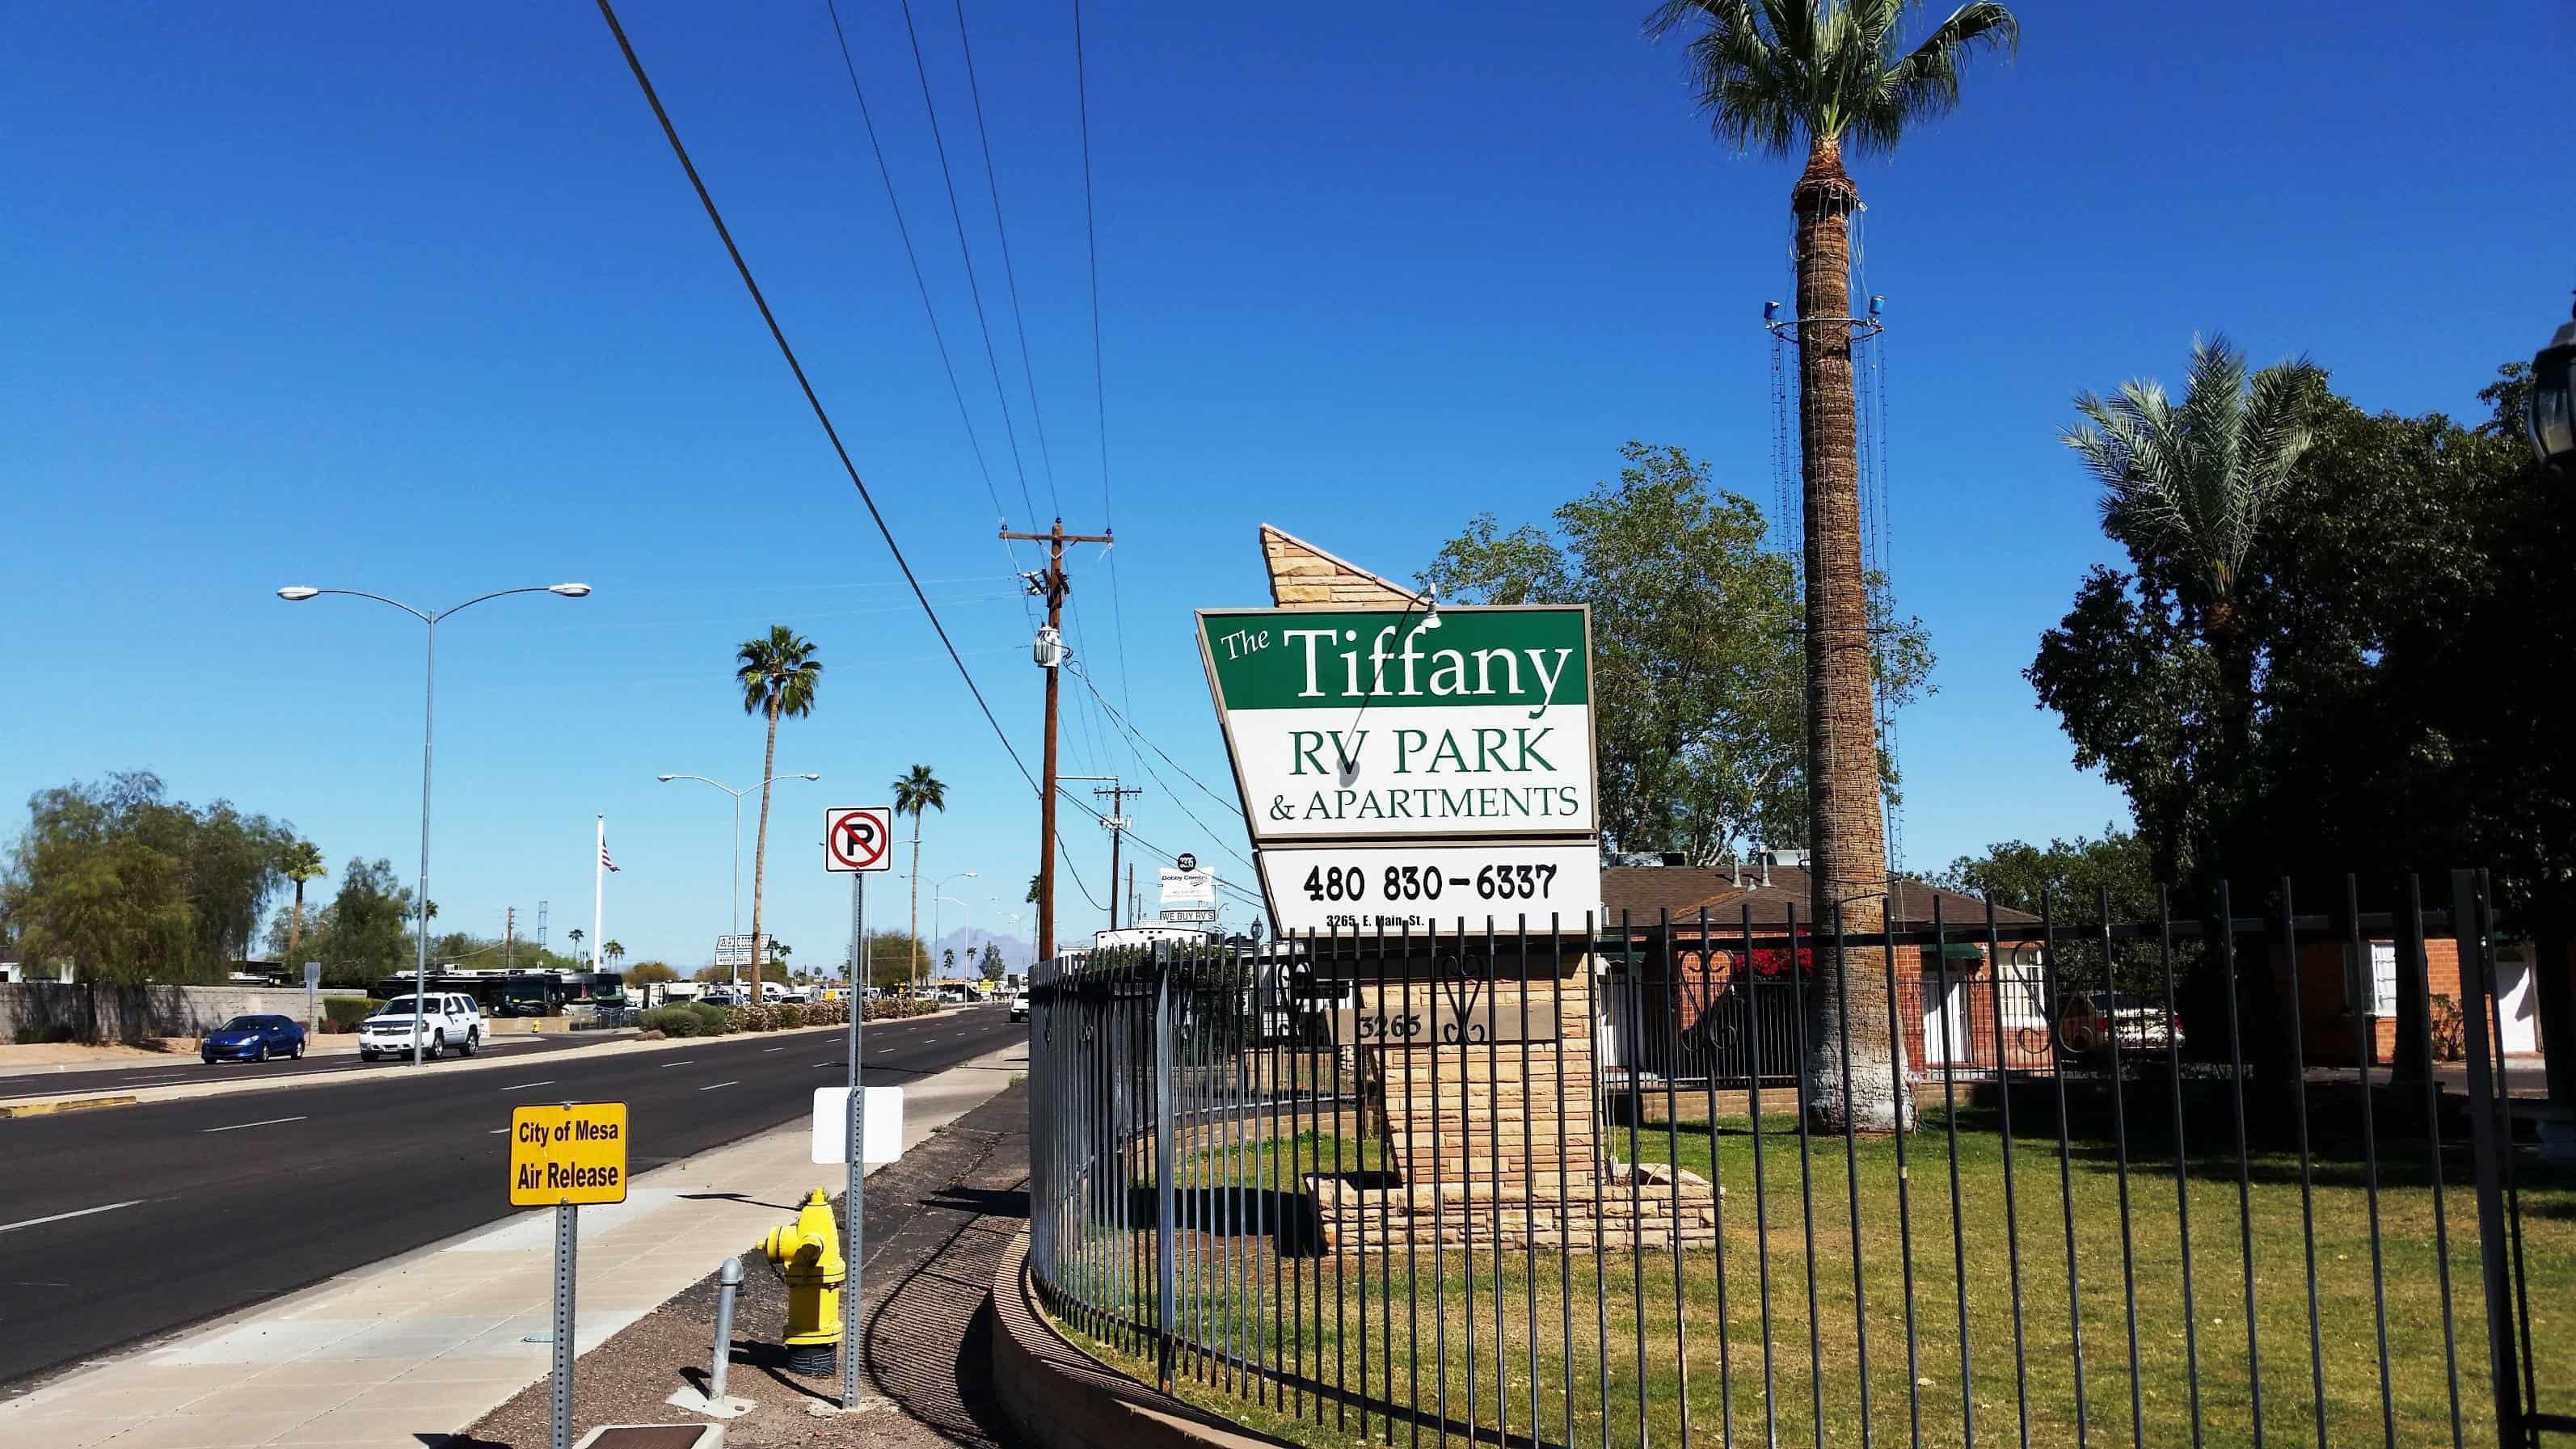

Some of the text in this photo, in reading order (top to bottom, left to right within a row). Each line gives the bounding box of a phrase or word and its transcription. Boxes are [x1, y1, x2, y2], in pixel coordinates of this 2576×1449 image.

[1220, 626, 1574, 719] The Tiffany
[1289, 727, 1558, 776] RV PARK
[1269, 786, 1579, 820] & APARTMENTS
[1303, 864, 1558, 901] 480 830-6337
[1162, 912, 1174, 920] WE
[1177, 912, 1194, 920] BUY
[1326, 914, 1425, 927] 3265 E. Main St.
[518, 1119, 618, 1148] City of Mesa
[517, 1161, 618, 1189] Air Release
